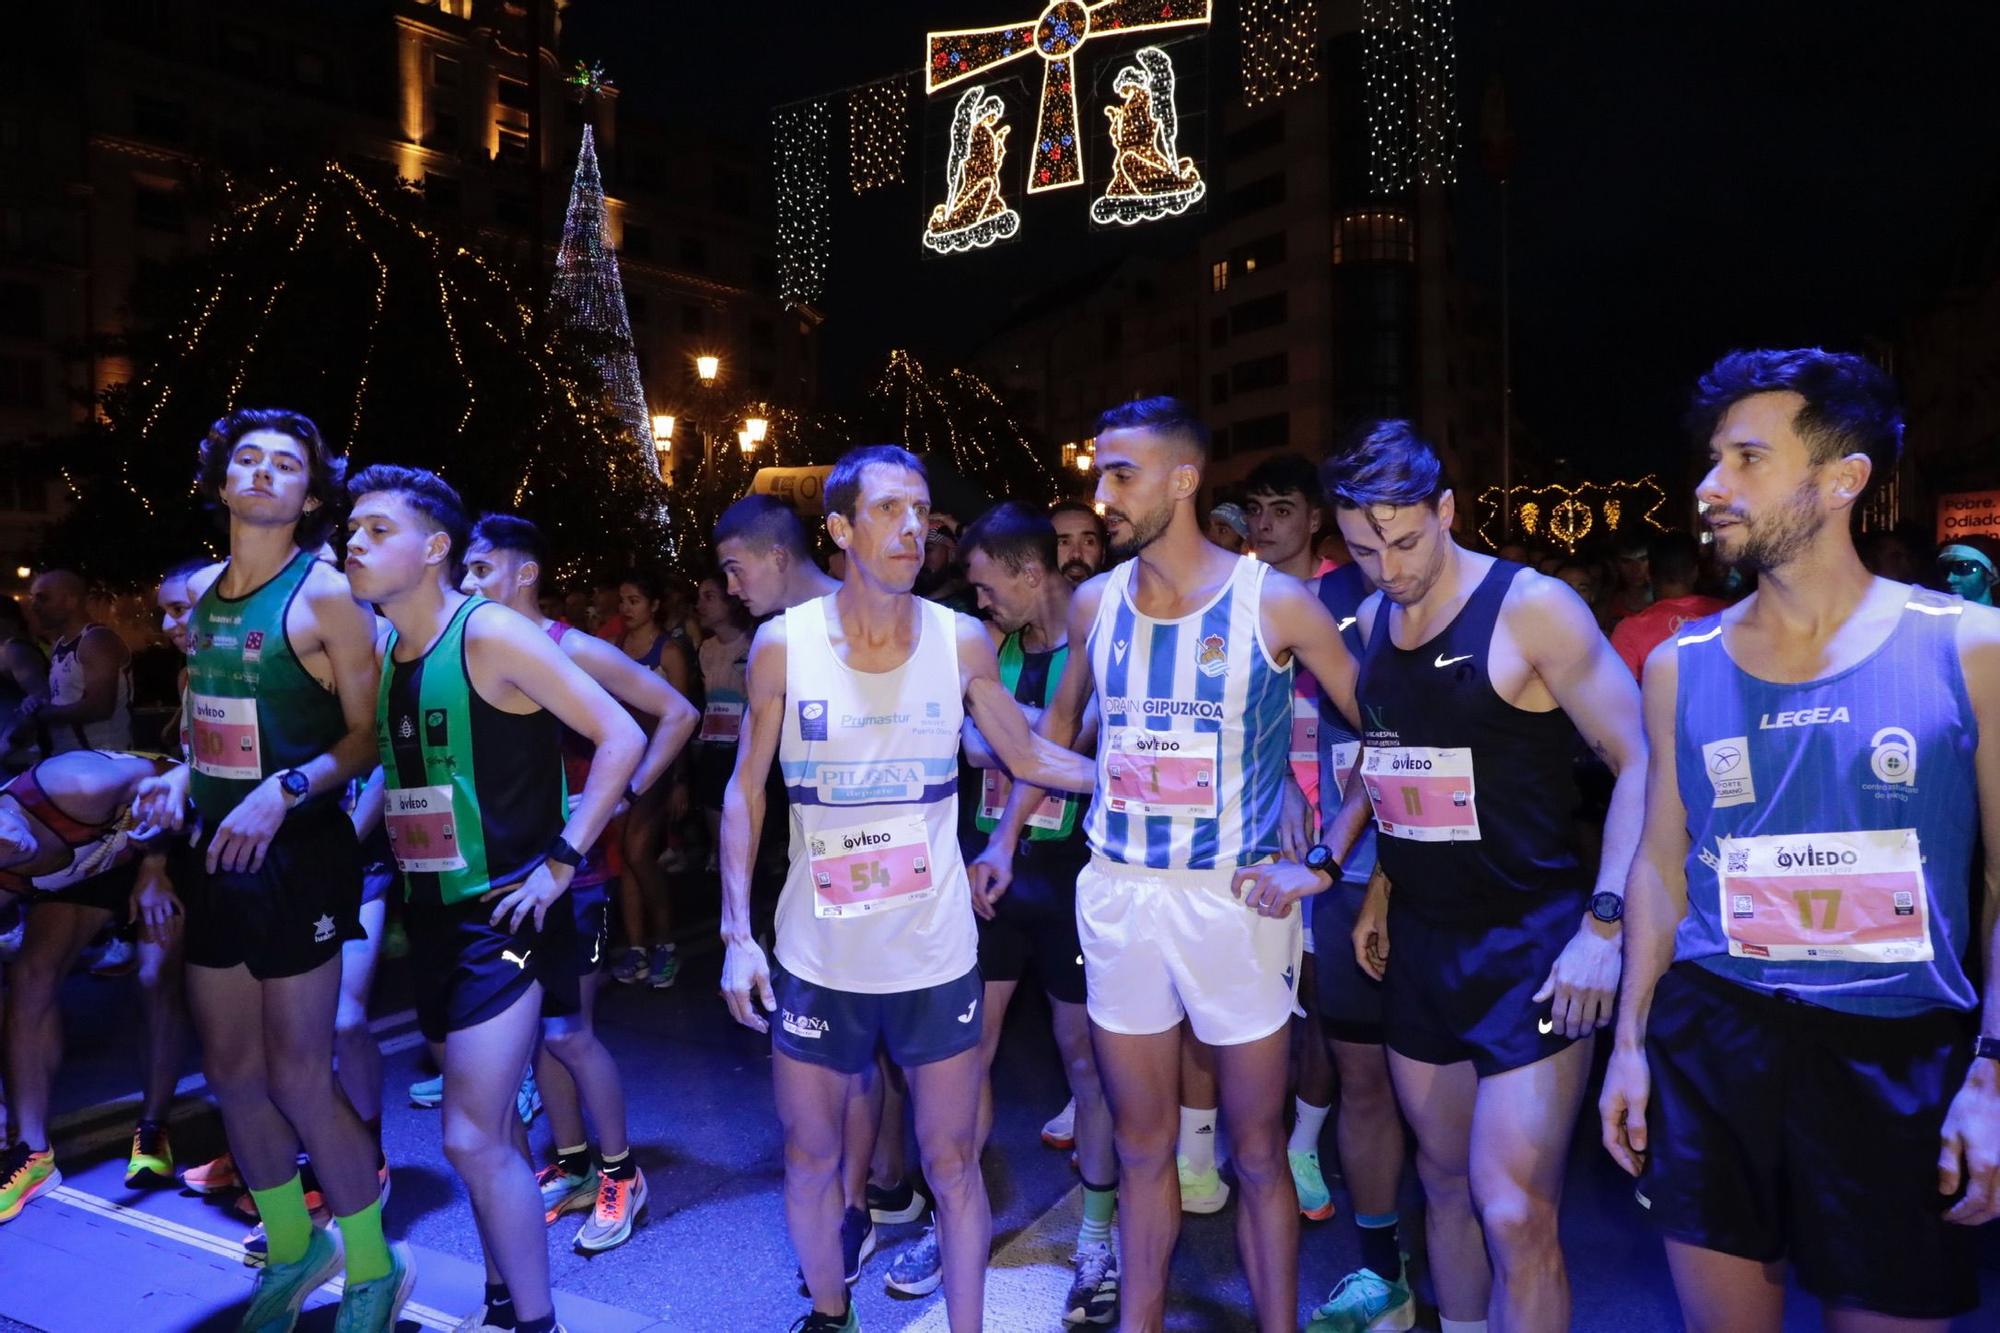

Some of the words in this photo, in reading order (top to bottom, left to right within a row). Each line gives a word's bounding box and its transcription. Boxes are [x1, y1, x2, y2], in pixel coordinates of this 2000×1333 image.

[1945, 498, 1996, 511] Pobre.
[841, 711, 911, 728] Prymastur
[1104, 699, 1139, 712] ORAIN
[1143, 700, 1224, 719] GIPUZKOA
[1759, 707, 1850, 730] LEGEA
[1392, 753, 1432, 770] OVIEDO
[1401, 786, 1423, 816] 11
[844, 829, 892, 849] OVIEDO
[1778, 842, 1858, 867] OVIEDO
[850, 860, 891, 893] 54
[1792, 889, 1843, 930] 17
